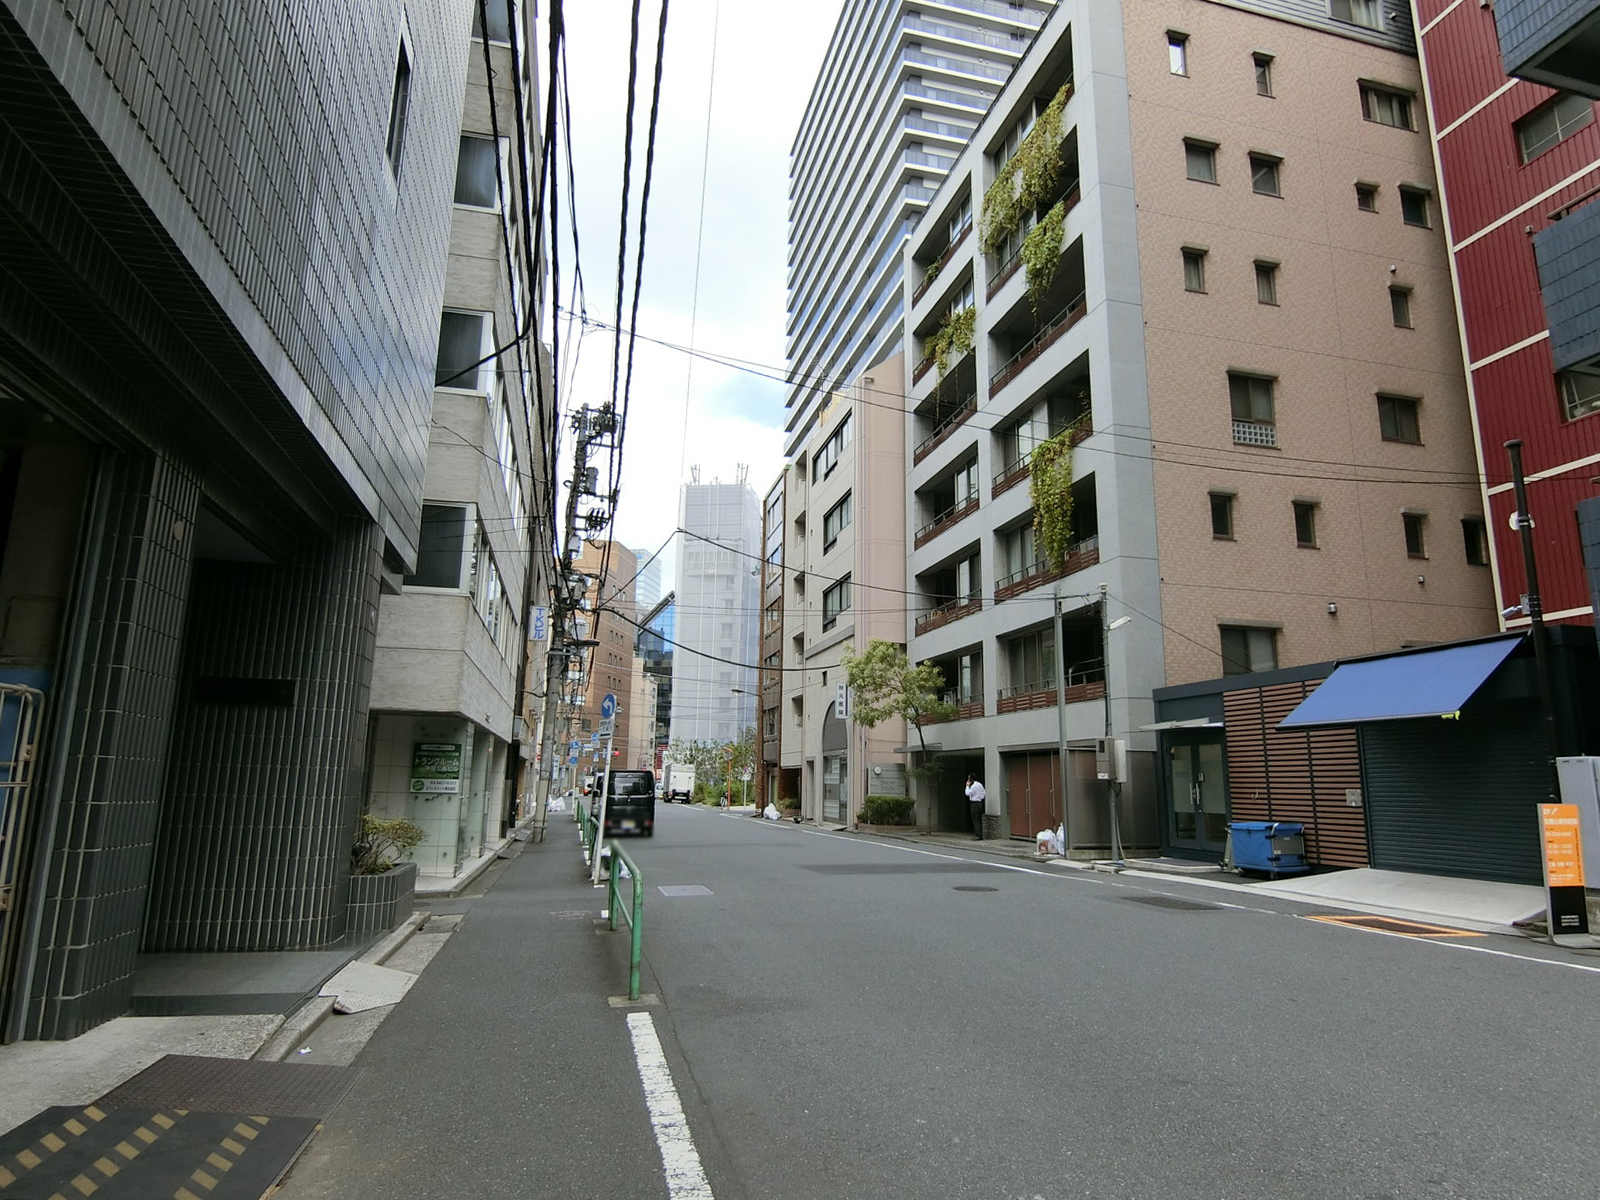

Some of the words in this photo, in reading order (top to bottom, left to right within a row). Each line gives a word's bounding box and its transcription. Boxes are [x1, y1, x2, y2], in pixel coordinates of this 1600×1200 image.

[533, 607, 545, 639] TKビル
[415, 757, 460, 766] トランクルーム
